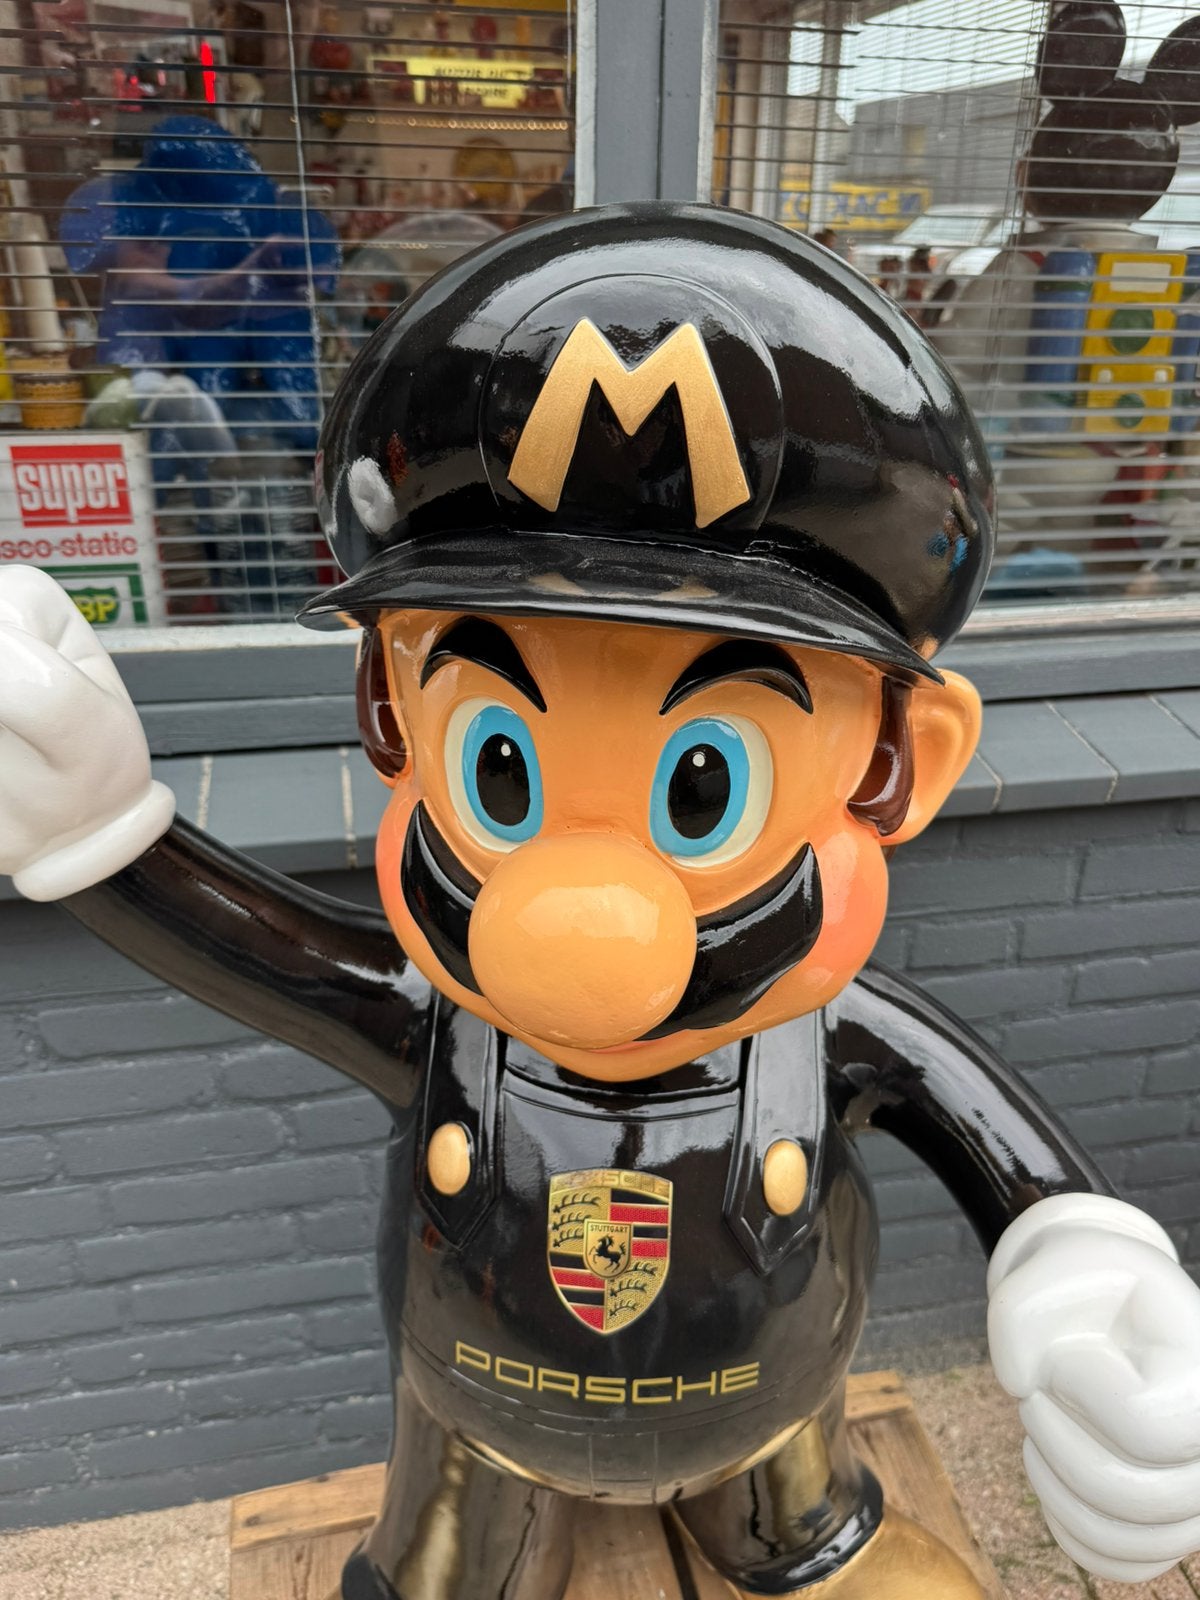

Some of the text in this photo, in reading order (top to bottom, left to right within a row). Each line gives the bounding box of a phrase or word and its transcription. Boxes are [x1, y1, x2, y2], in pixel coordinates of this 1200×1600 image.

[508, 318, 751, 528] M
[17, 464, 125, 523] super
[0, 532, 137, 559] sco-static
[74, 596, 116, 622] BP
[590, 1224, 629, 1232] STUTTGART
[456, 1341, 760, 1403] PORSCHE
